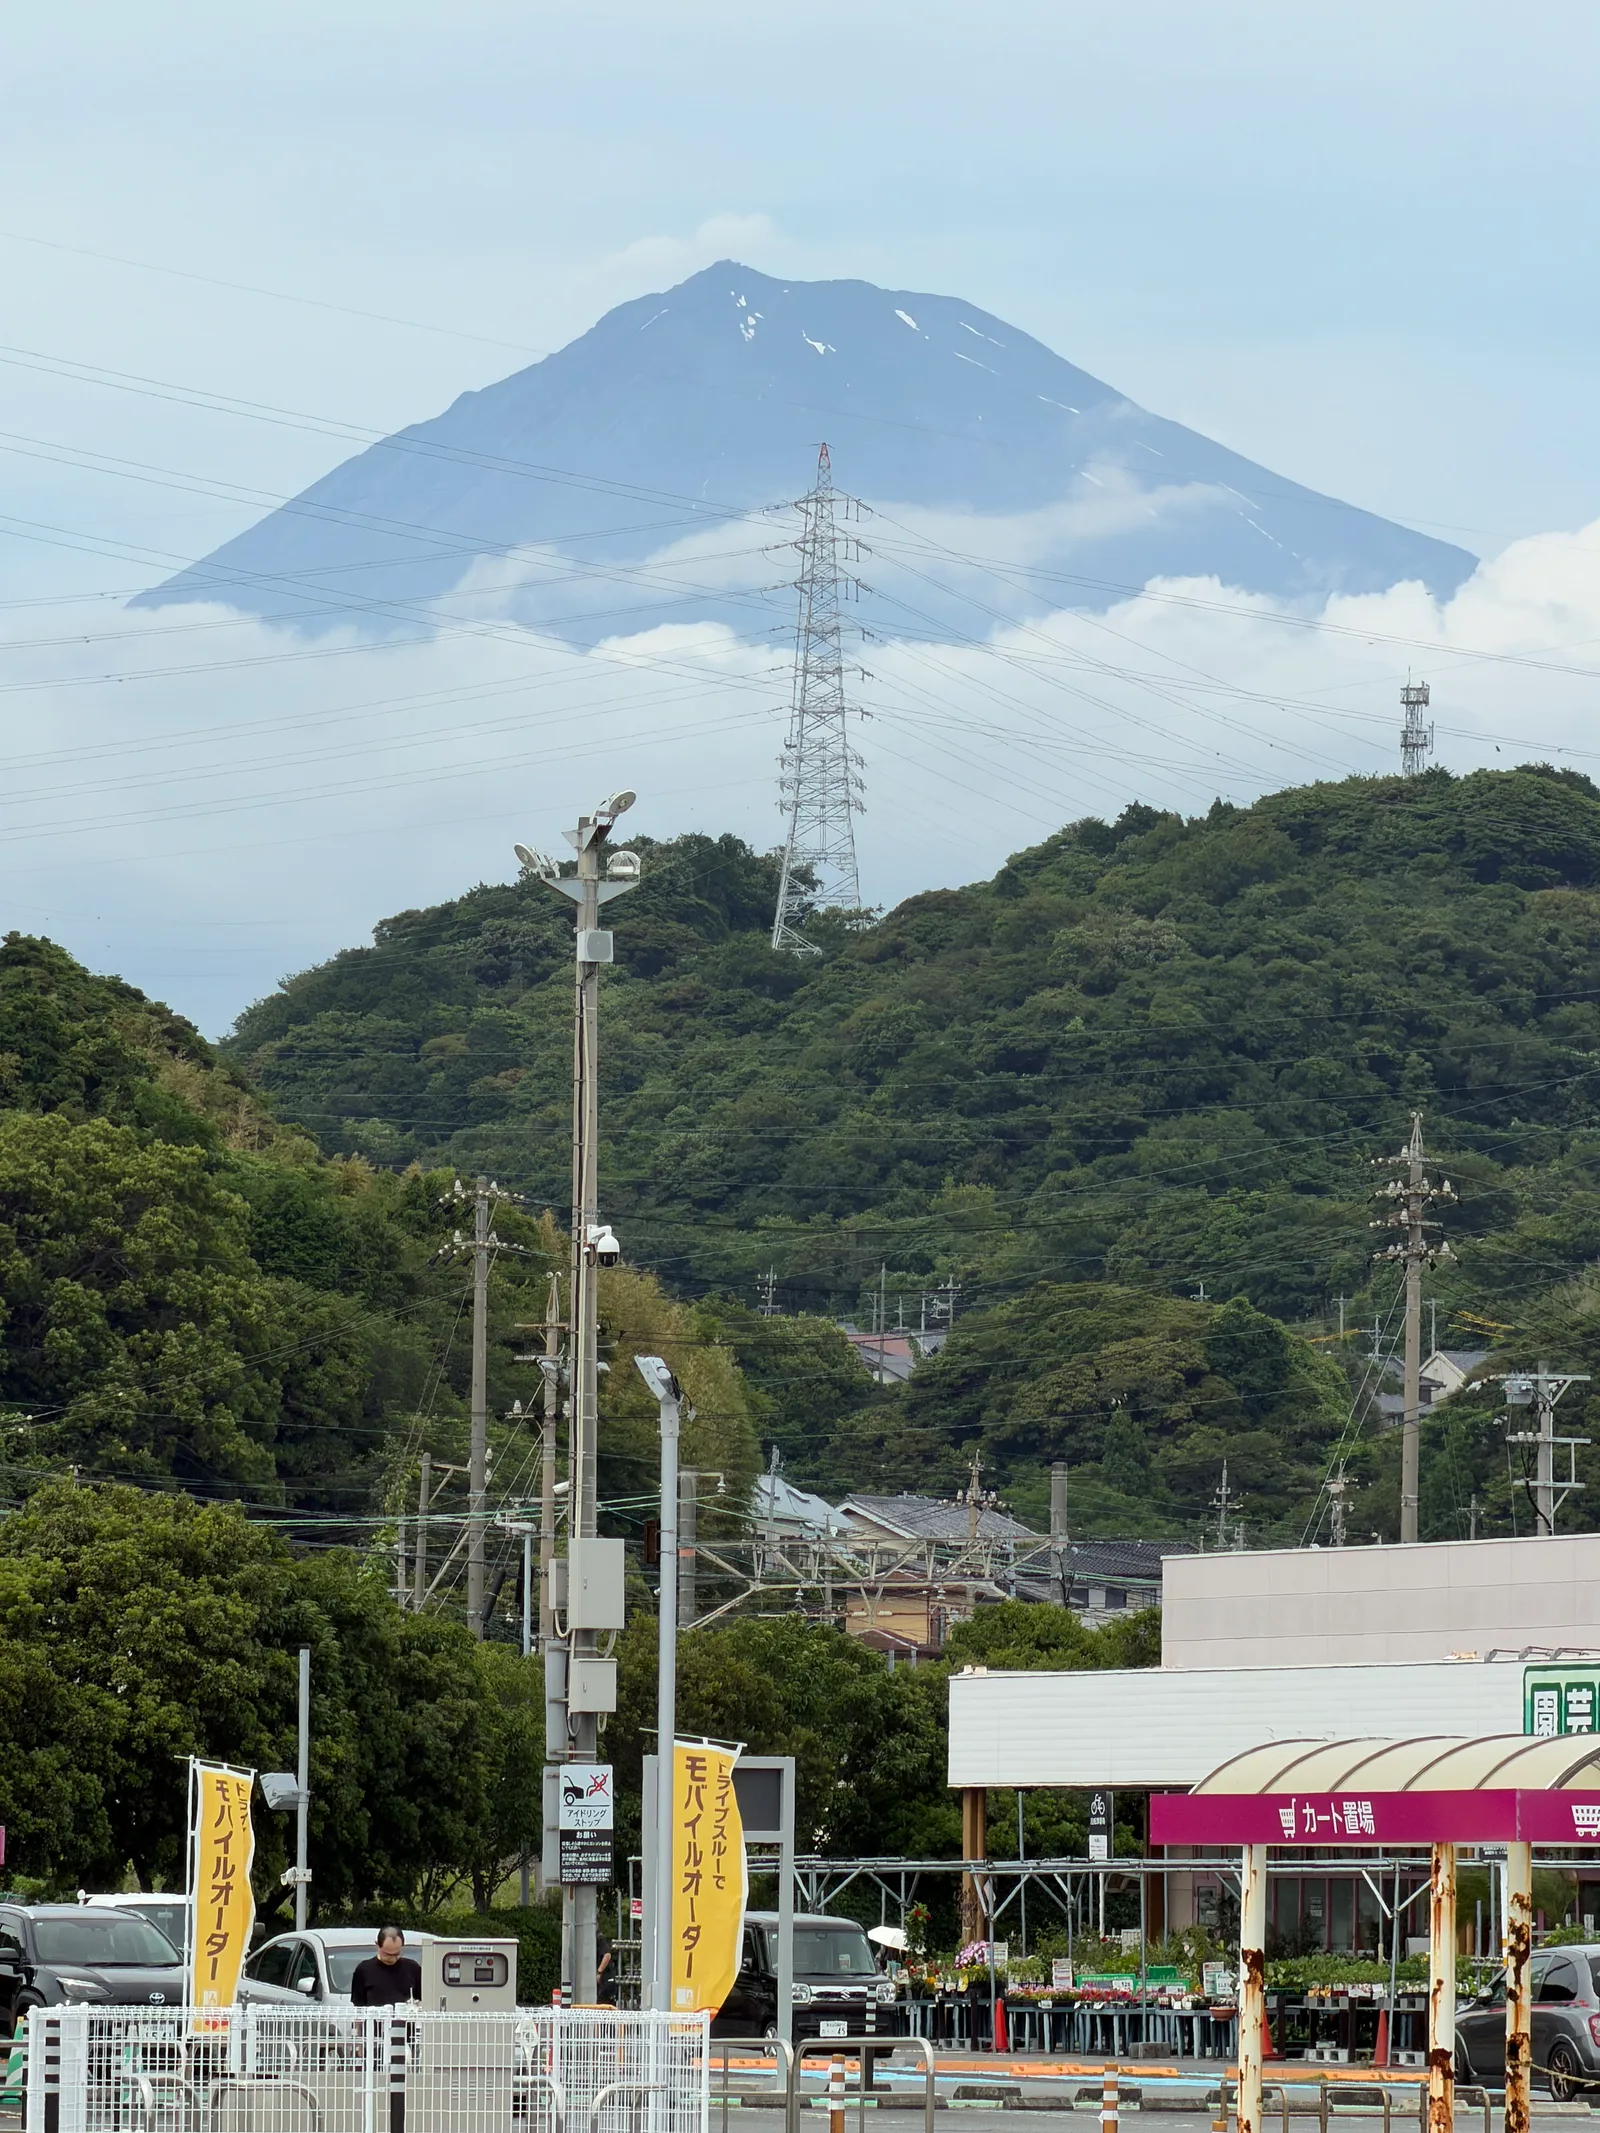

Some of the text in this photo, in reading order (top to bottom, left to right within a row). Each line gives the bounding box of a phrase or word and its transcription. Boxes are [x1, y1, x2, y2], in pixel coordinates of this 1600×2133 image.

[567, 1809, 607, 1818] アイドリング
[574, 1818, 601, 1827] ストップ
[1302, 1801, 1375, 1834] カート置場
[682, 1756, 708, 1979] モバイルオーダー
